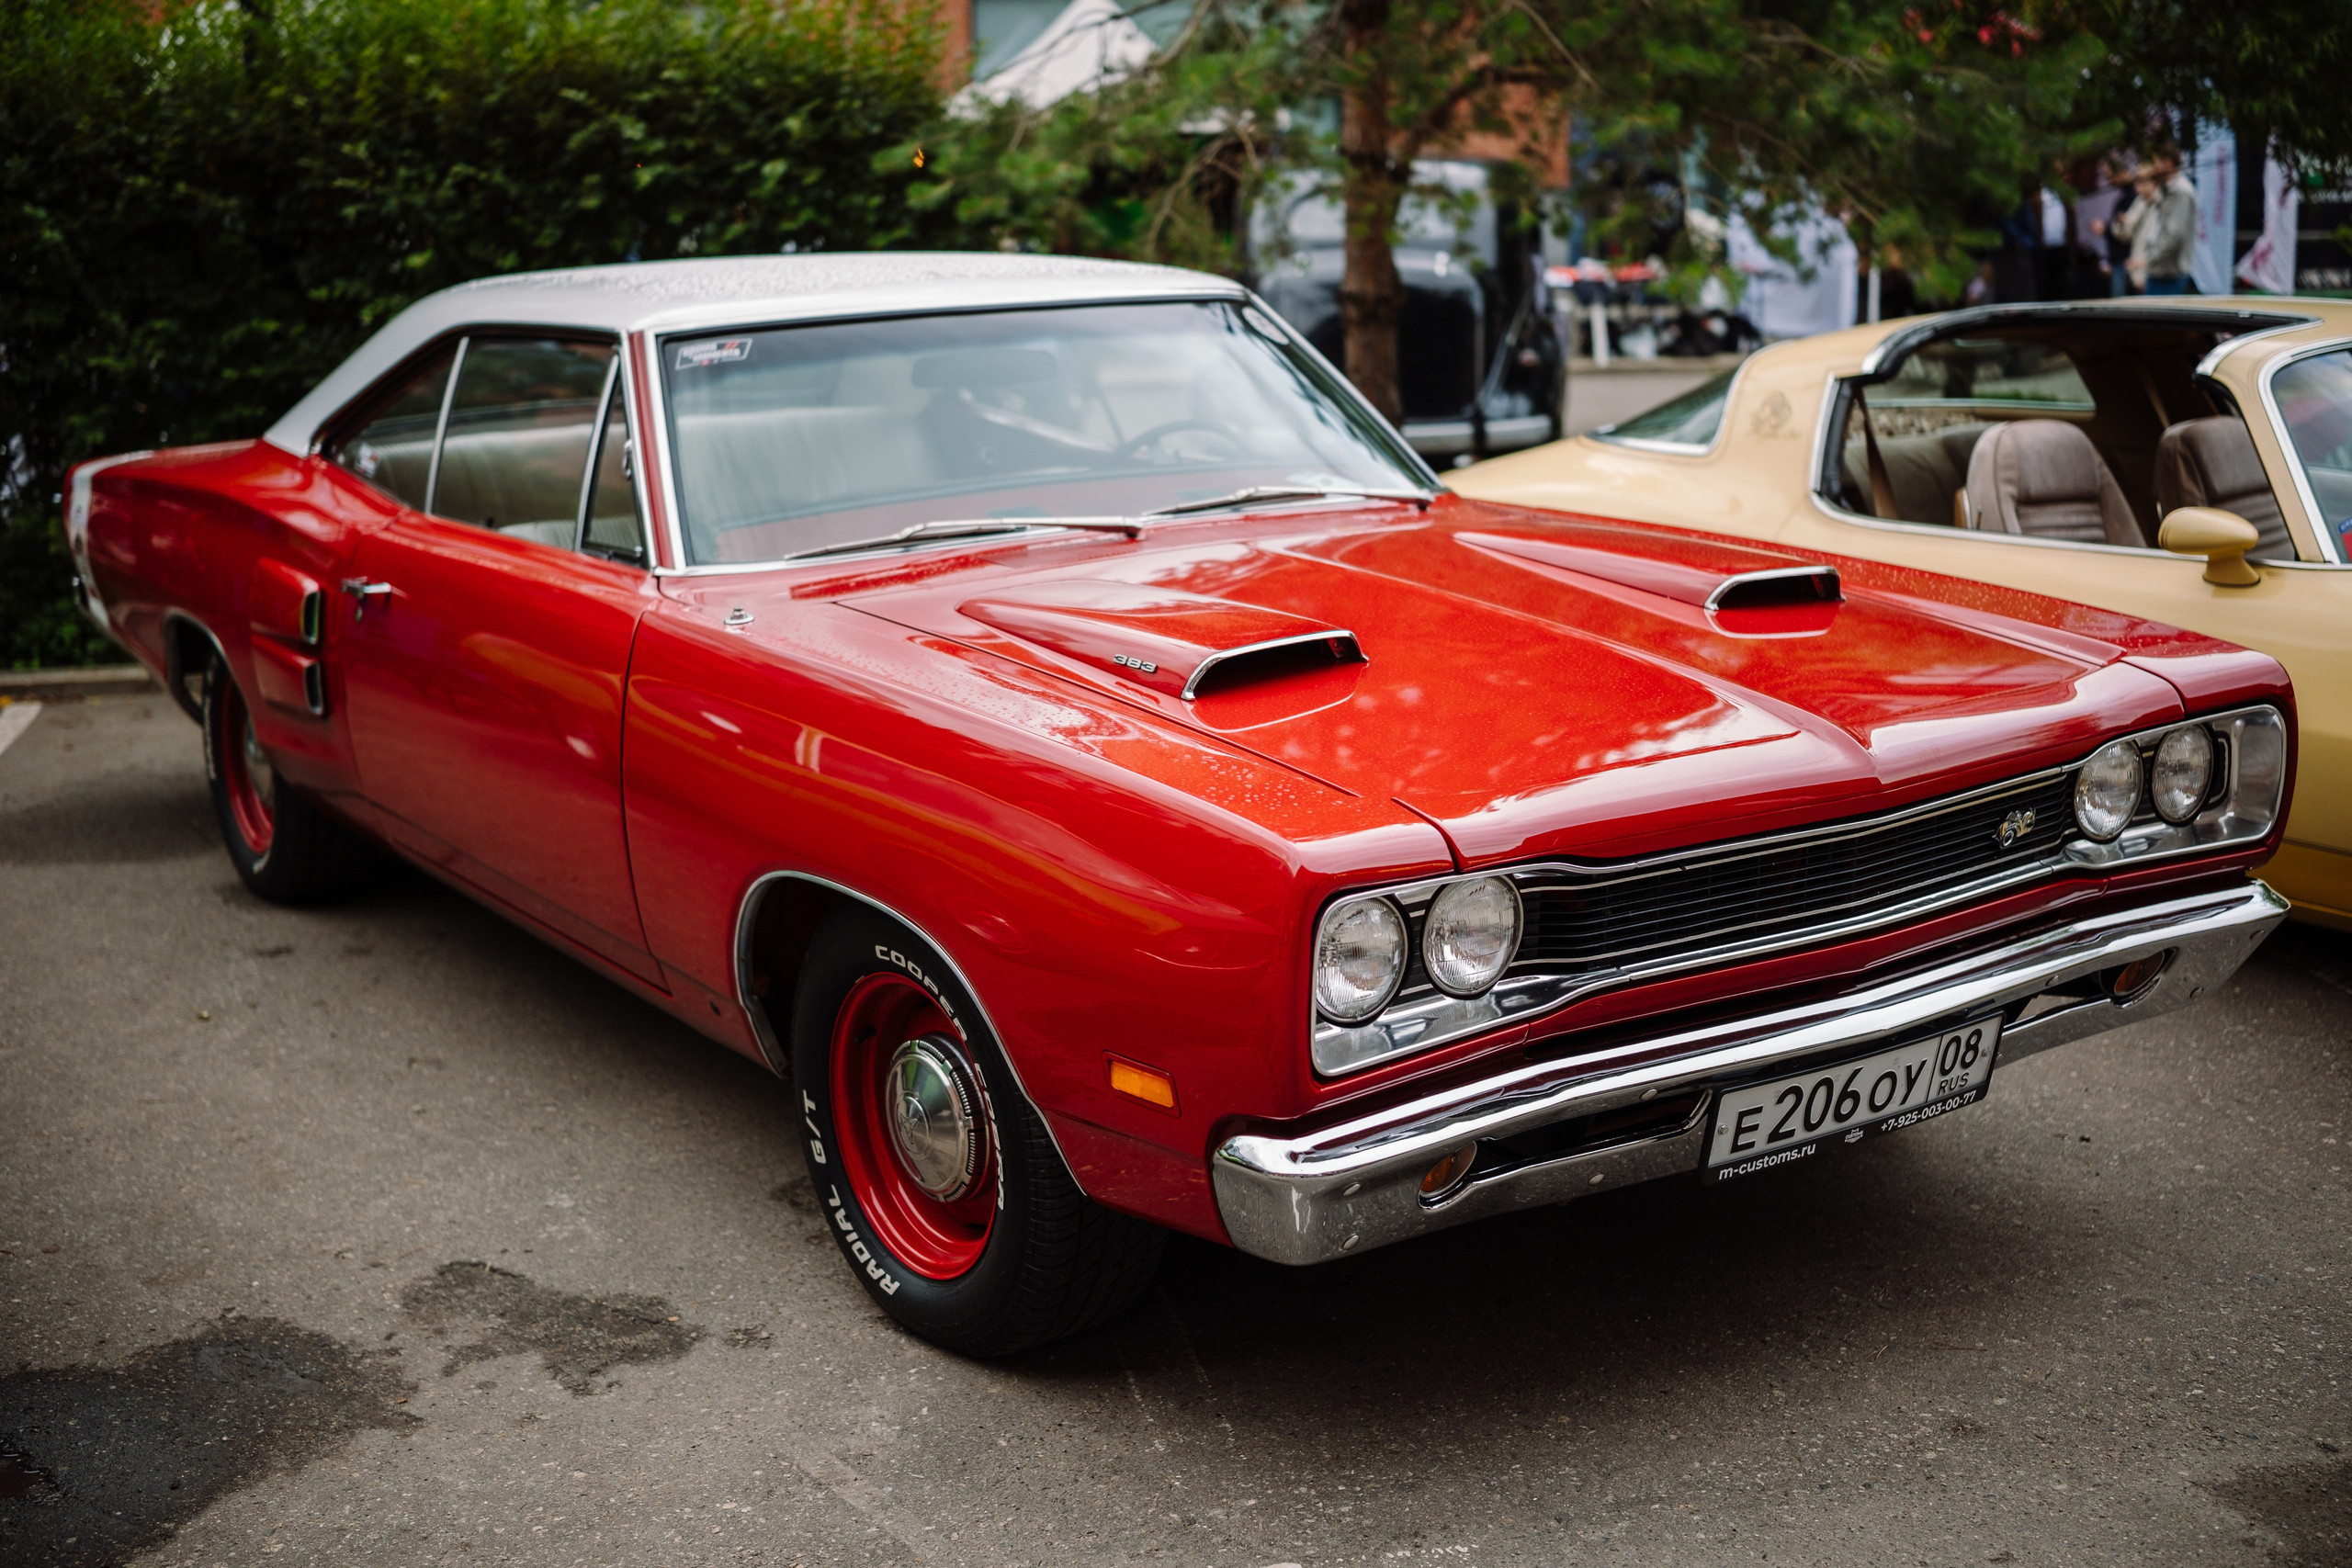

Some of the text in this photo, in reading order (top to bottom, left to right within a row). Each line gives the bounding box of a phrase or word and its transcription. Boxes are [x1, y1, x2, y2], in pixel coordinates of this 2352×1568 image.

[1114, 653, 1157, 673] 383
[875, 944, 968, 1043] COOPER
[1939, 1028, 1983, 1077] 08
[1937, 1072, 1970, 1097] RUS
[1881, 1090, 1977, 1133] +7-925-003-00-77
[1718, 1144, 1816, 1180] m-customs.ru
[803, 1089, 901, 1296] RADIAL G/T
